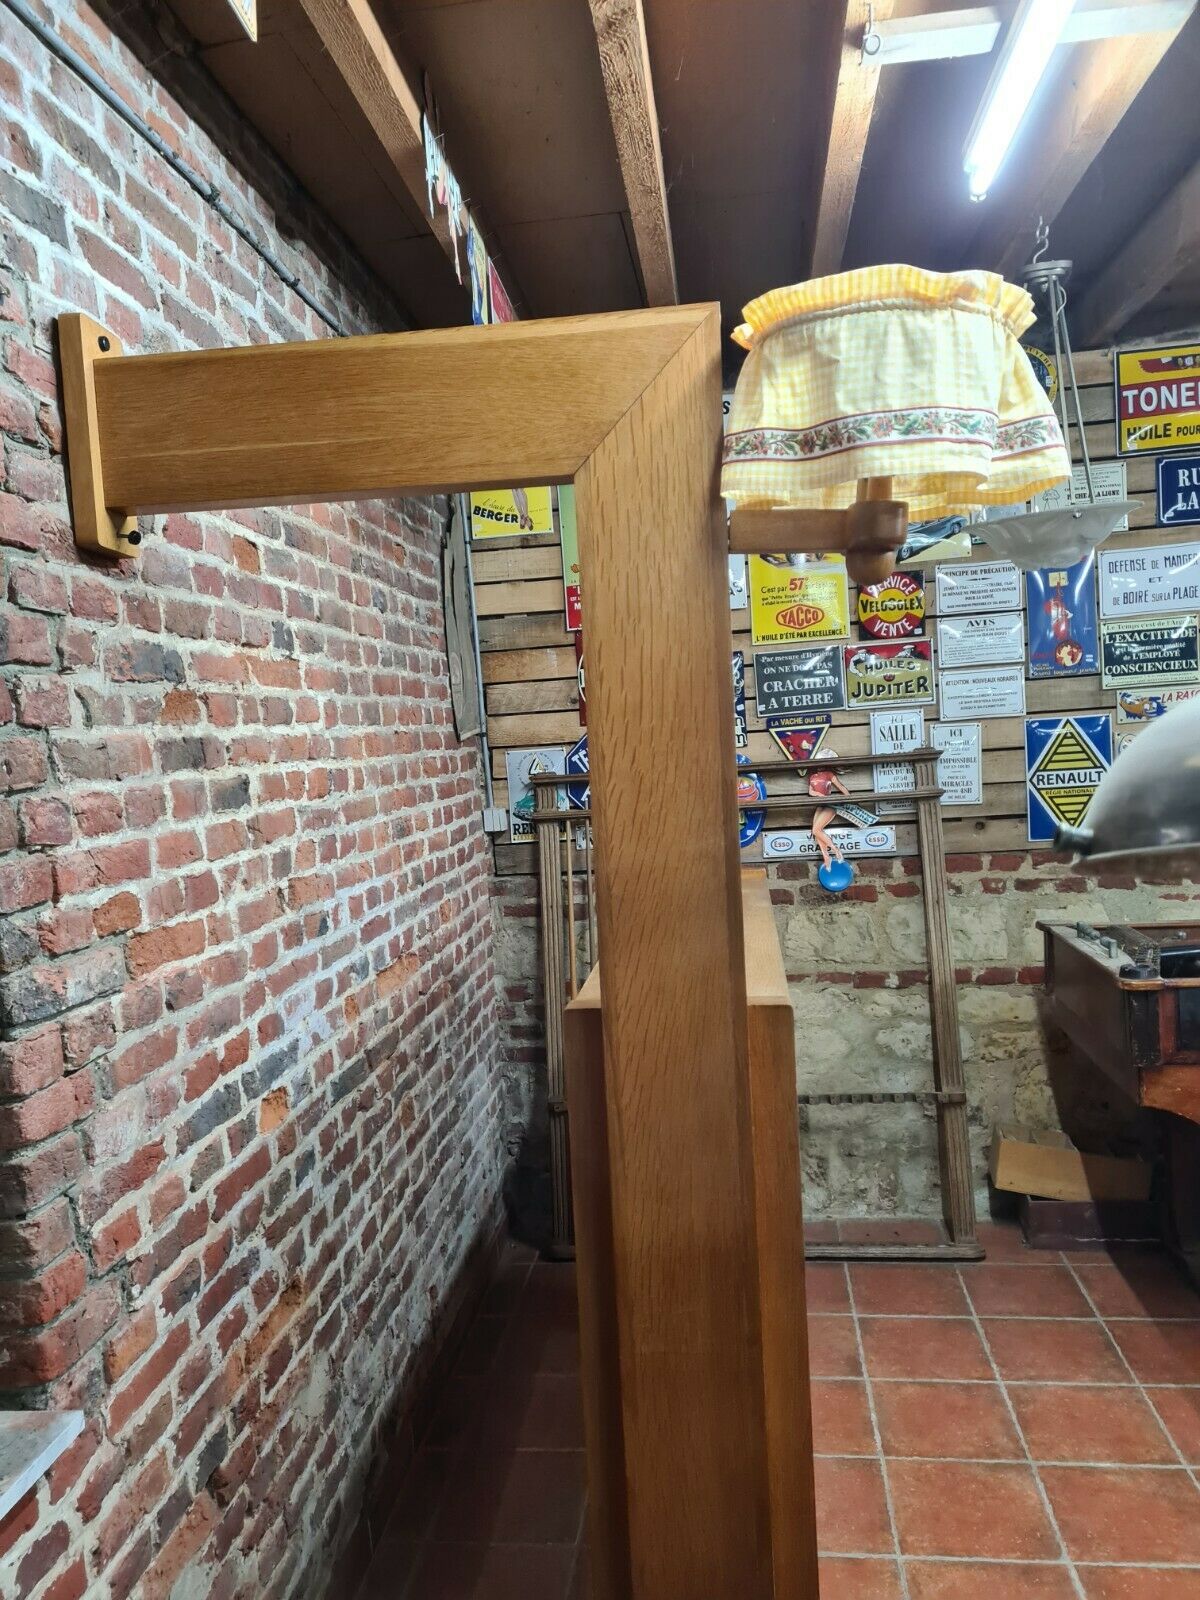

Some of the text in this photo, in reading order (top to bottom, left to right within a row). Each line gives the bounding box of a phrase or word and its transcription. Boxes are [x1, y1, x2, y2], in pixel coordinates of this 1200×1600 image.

[1122, 382, 1200, 414] TONE
[1126, 422, 1172, 440] HUILE
[473, 505, 519, 524] BERGER
[1151, 560, 1159, 570] DE
[942, 569, 968, 577] RINCIPE
[1148, 576, 1164, 584] ET
[868, 576, 917, 598] SERVICE
[1112, 596, 1120, 606] DE
[1123, 590, 1149, 605] BOIRE
[1172, 585, 1199, 600] PLAGE
[780, 606, 819, 627] YACCO
[966, 618, 996, 628] AVIS
[874, 618, 914, 636] VENTE
[756, 634, 778, 642] L'HUILE
[808, 628, 842, 638] EXCELLENCE
[774, 654, 800, 662] mesure
[1132, 649, 1180, 660] L'EMPLOYÉ
[764, 666, 776, 674] ON
[816, 662, 833, 670] PAS
[864, 660, 916, 674] HUILES
[1105, 659, 1198, 676] CONSCIENCIEUX
[763, 676, 836, 692] CRACHER
[852, 676, 930, 698] JUPITER
[768, 692, 834, 709] A TERRE
[1161, 692, 1173, 704] LA
[780, 718, 804, 726] VACHE
[816, 714, 828, 722] RIT
[880, 724, 917, 742] SALLE
[950, 728, 963, 738] ICI
[893, 742, 904, 750] DE
[942, 780, 974, 788] MIRACLES
[1036, 770, 1104, 786] RENAULT
